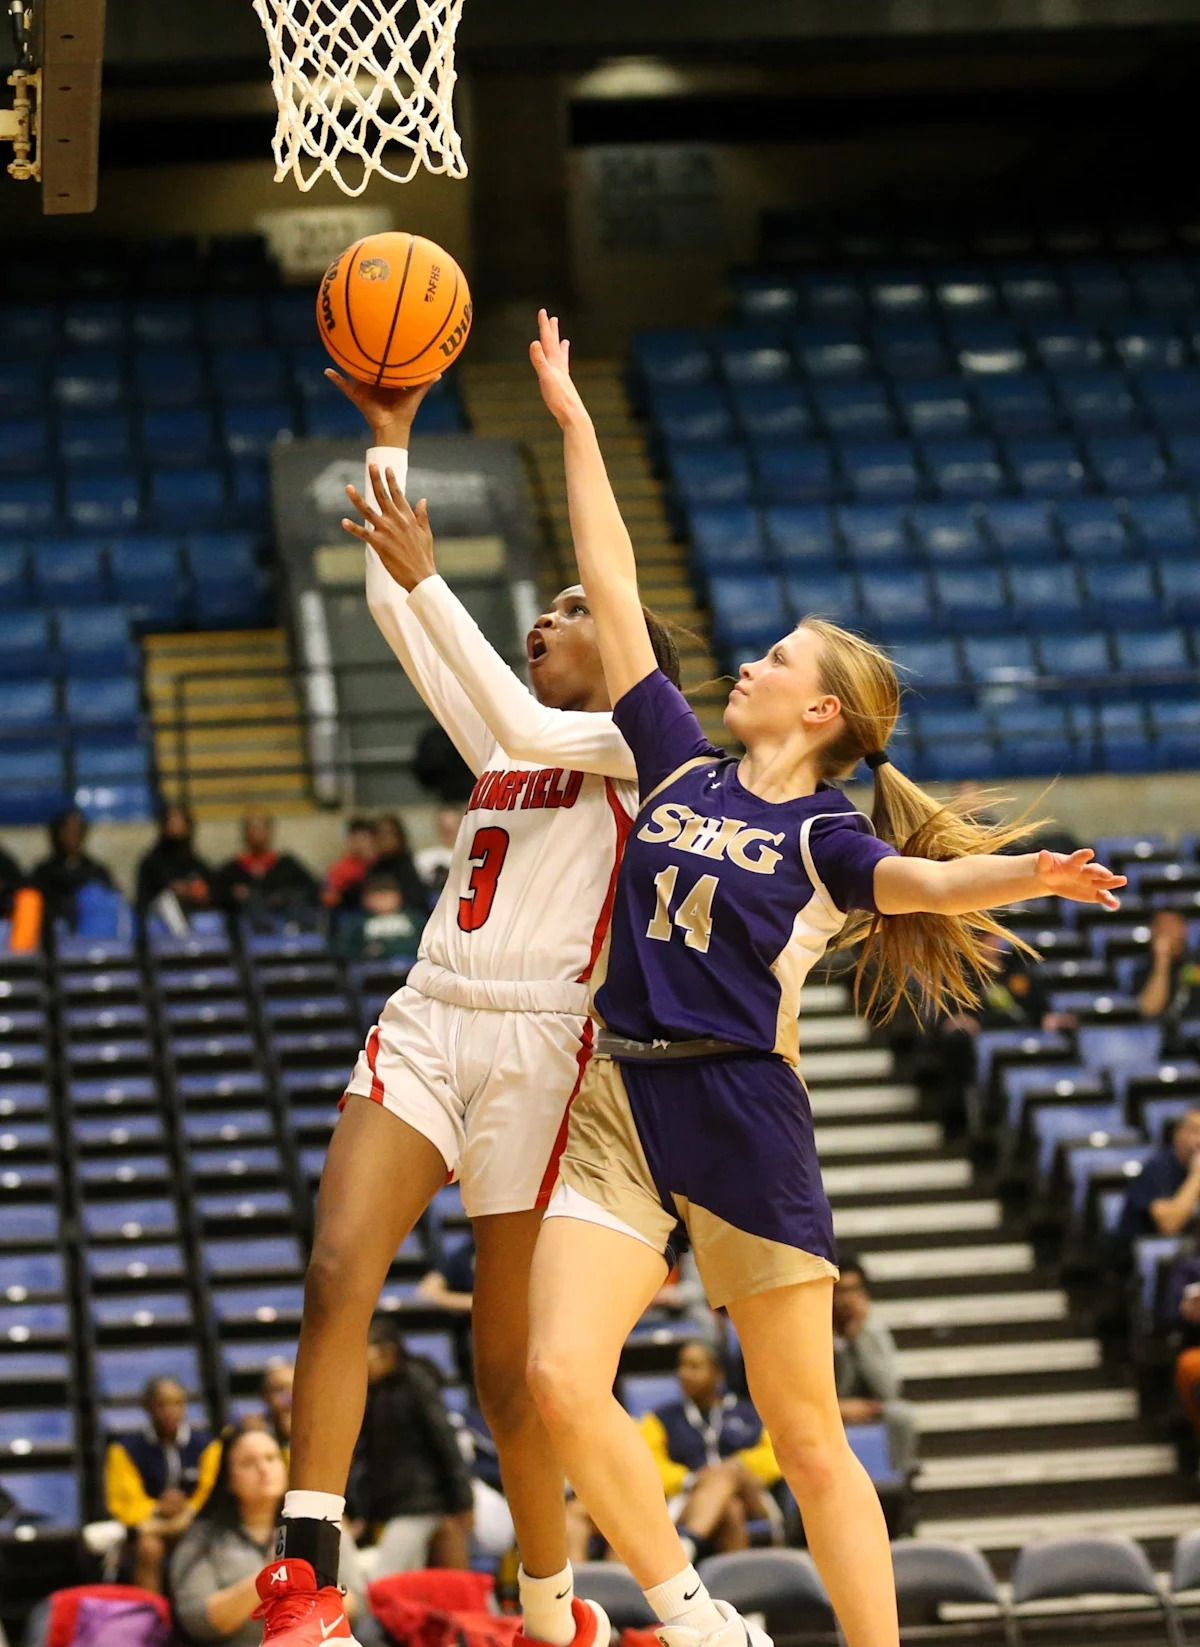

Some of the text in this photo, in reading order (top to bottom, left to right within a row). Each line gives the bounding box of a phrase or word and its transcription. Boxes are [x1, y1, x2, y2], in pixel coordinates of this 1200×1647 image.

[427, 264, 441, 295] NFHS
[465, 768, 584, 815] RINGFIELD
[637, 803, 786, 875] SHG
[457, 826, 510, 933] 3
[646, 865, 720, 954] 14
